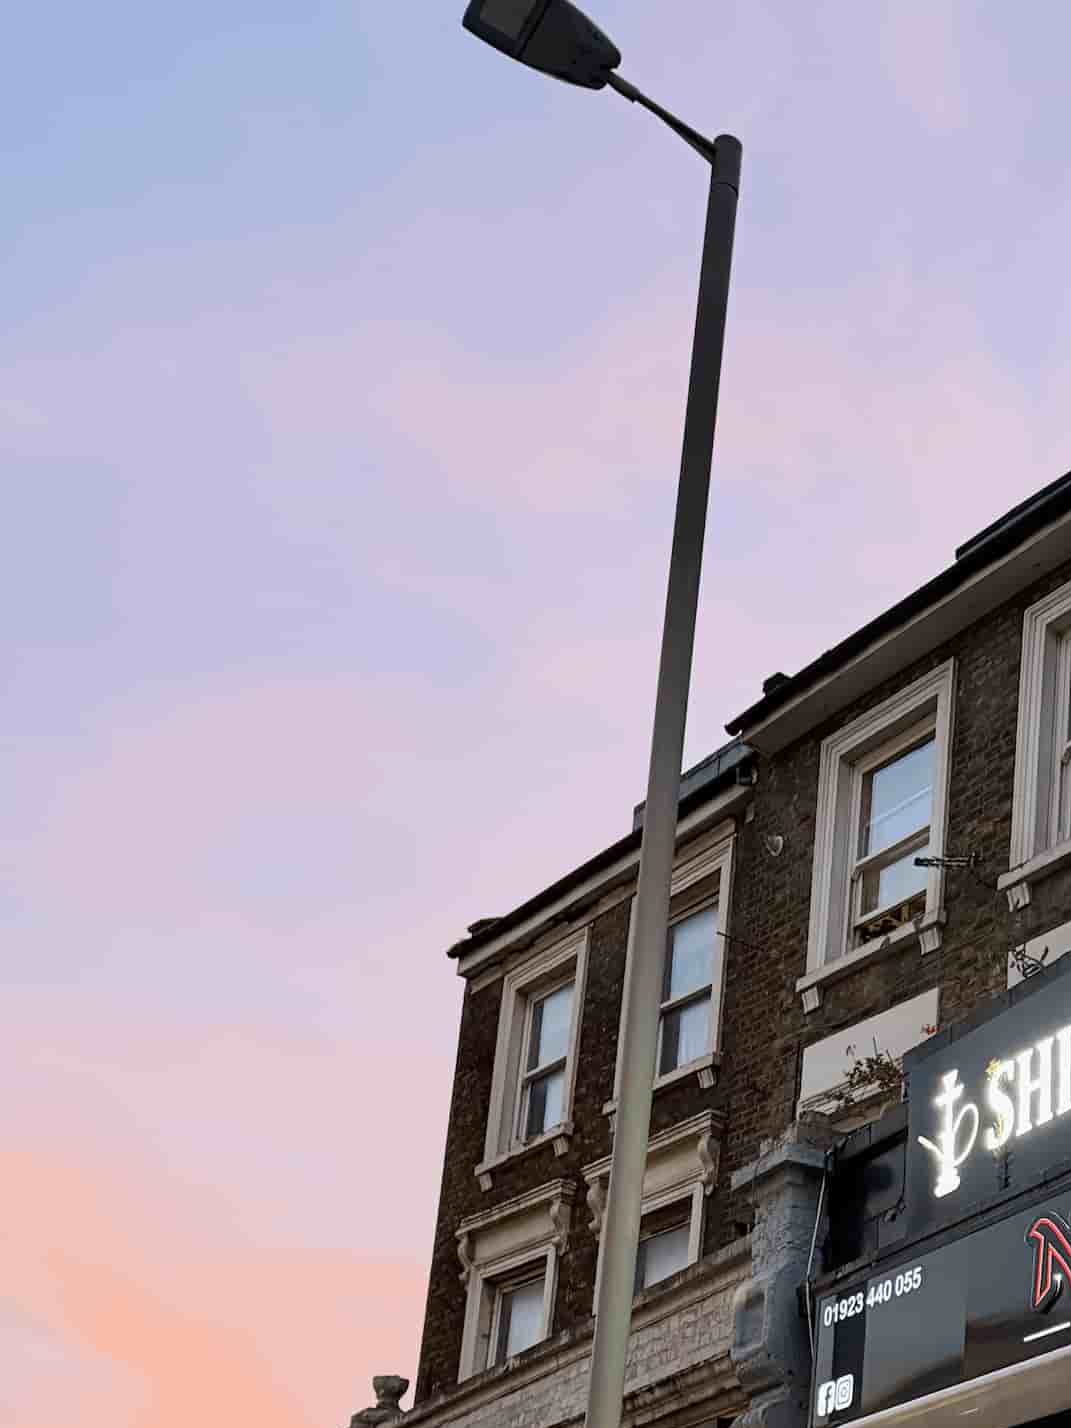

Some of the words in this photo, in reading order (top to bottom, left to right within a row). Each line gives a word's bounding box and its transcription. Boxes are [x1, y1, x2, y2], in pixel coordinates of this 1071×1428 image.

[823, 1292, 864, 1326] 01923
[866, 1279, 892, 1308] 440
[895, 1266, 922, 1297] 055
